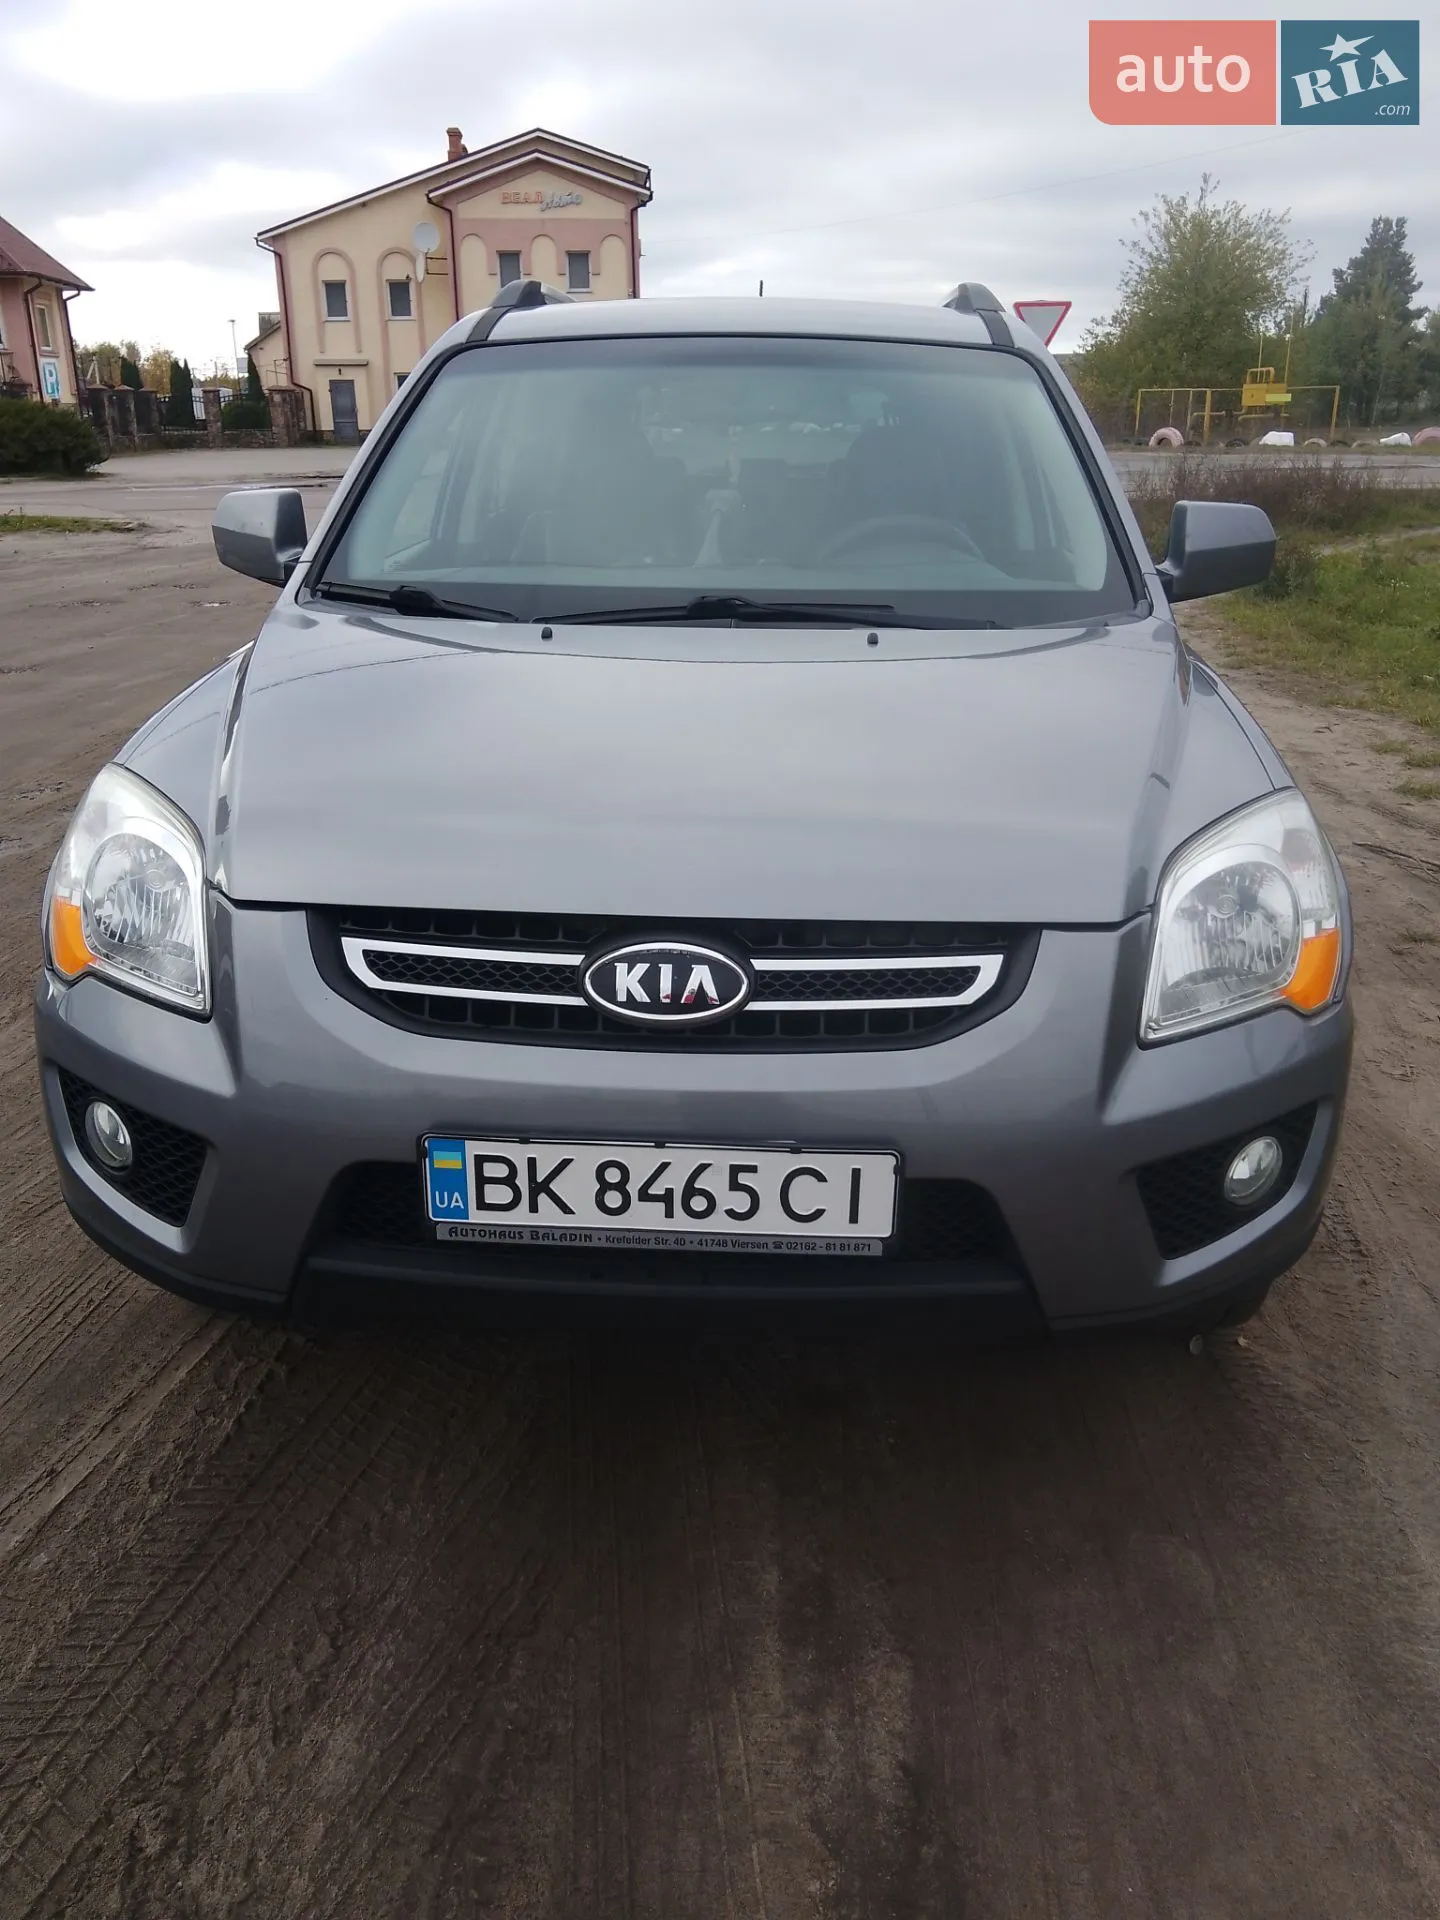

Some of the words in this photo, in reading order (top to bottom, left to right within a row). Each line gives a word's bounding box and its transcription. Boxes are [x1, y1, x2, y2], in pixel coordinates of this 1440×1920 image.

[614, 962, 720, 1005] KIA
[435, 1190, 465, 1209] UA
[474, 1153, 577, 1215] BK
[594, 1160, 760, 1221] 8465
[779, 1166, 862, 1225] CI
[530, 1229, 593, 1244] BALADIN
[605, 1234, 651, 1246] Krefelder
[654, 1236, 671, 1247] Str.
[673, 1237, 686, 1247] 40
[697, 1238, 728, 1248] 41748
[731, 1239, 769, 1250] Viersen
[825, 1242, 837, 1252] 81
[839, 1242, 851, 1252] 81
[853, 1243, 871, 1253] 871
